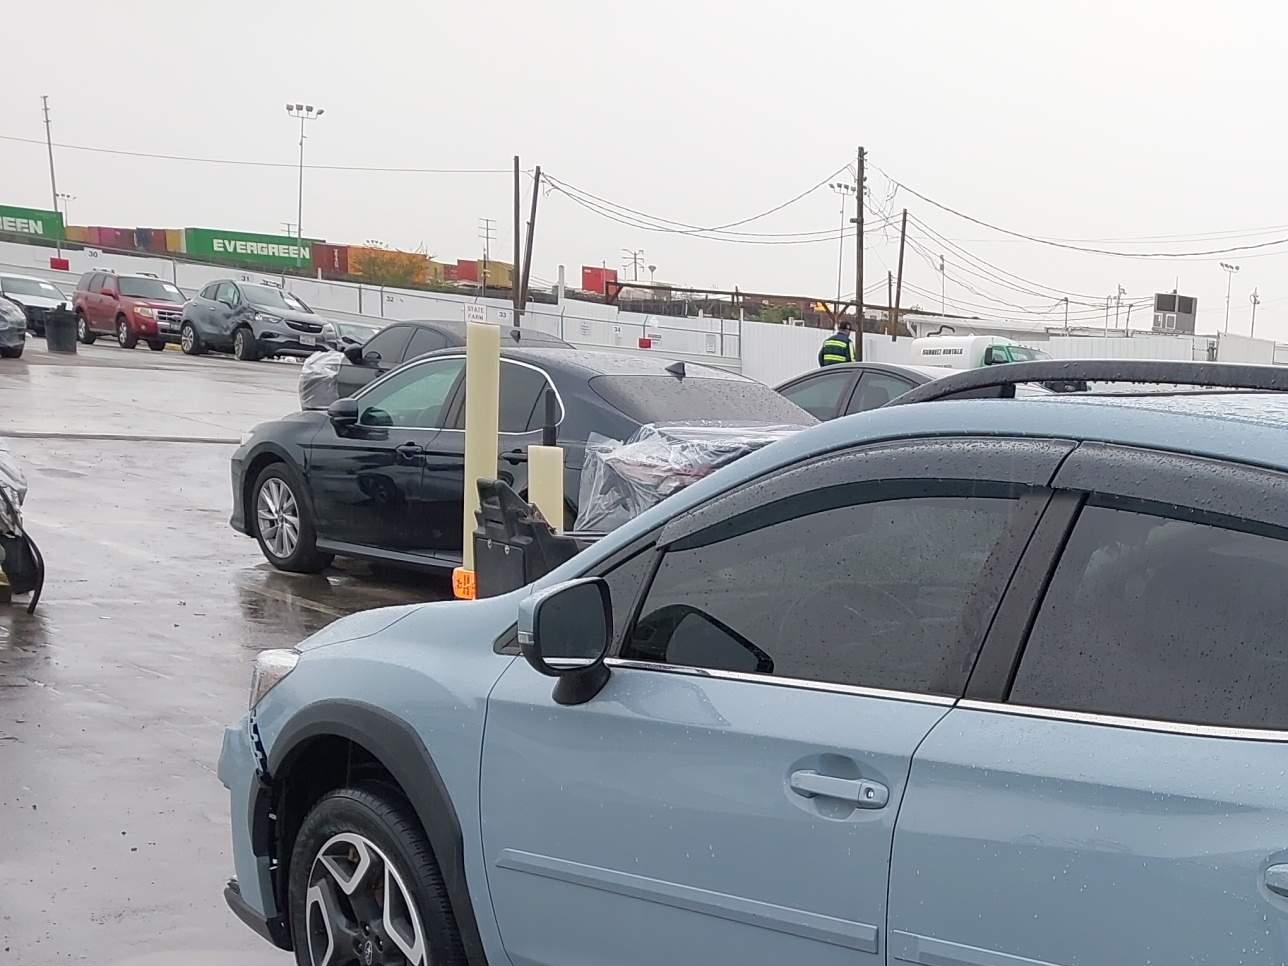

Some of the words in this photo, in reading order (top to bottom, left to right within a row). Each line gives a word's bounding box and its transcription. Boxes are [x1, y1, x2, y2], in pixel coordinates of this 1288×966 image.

[0, 216, 43, 234] EEN
[212, 238, 310, 259] EVERGREEN
[467, 305, 484, 313] STATE
[467, 313, 484, 321] FARM
